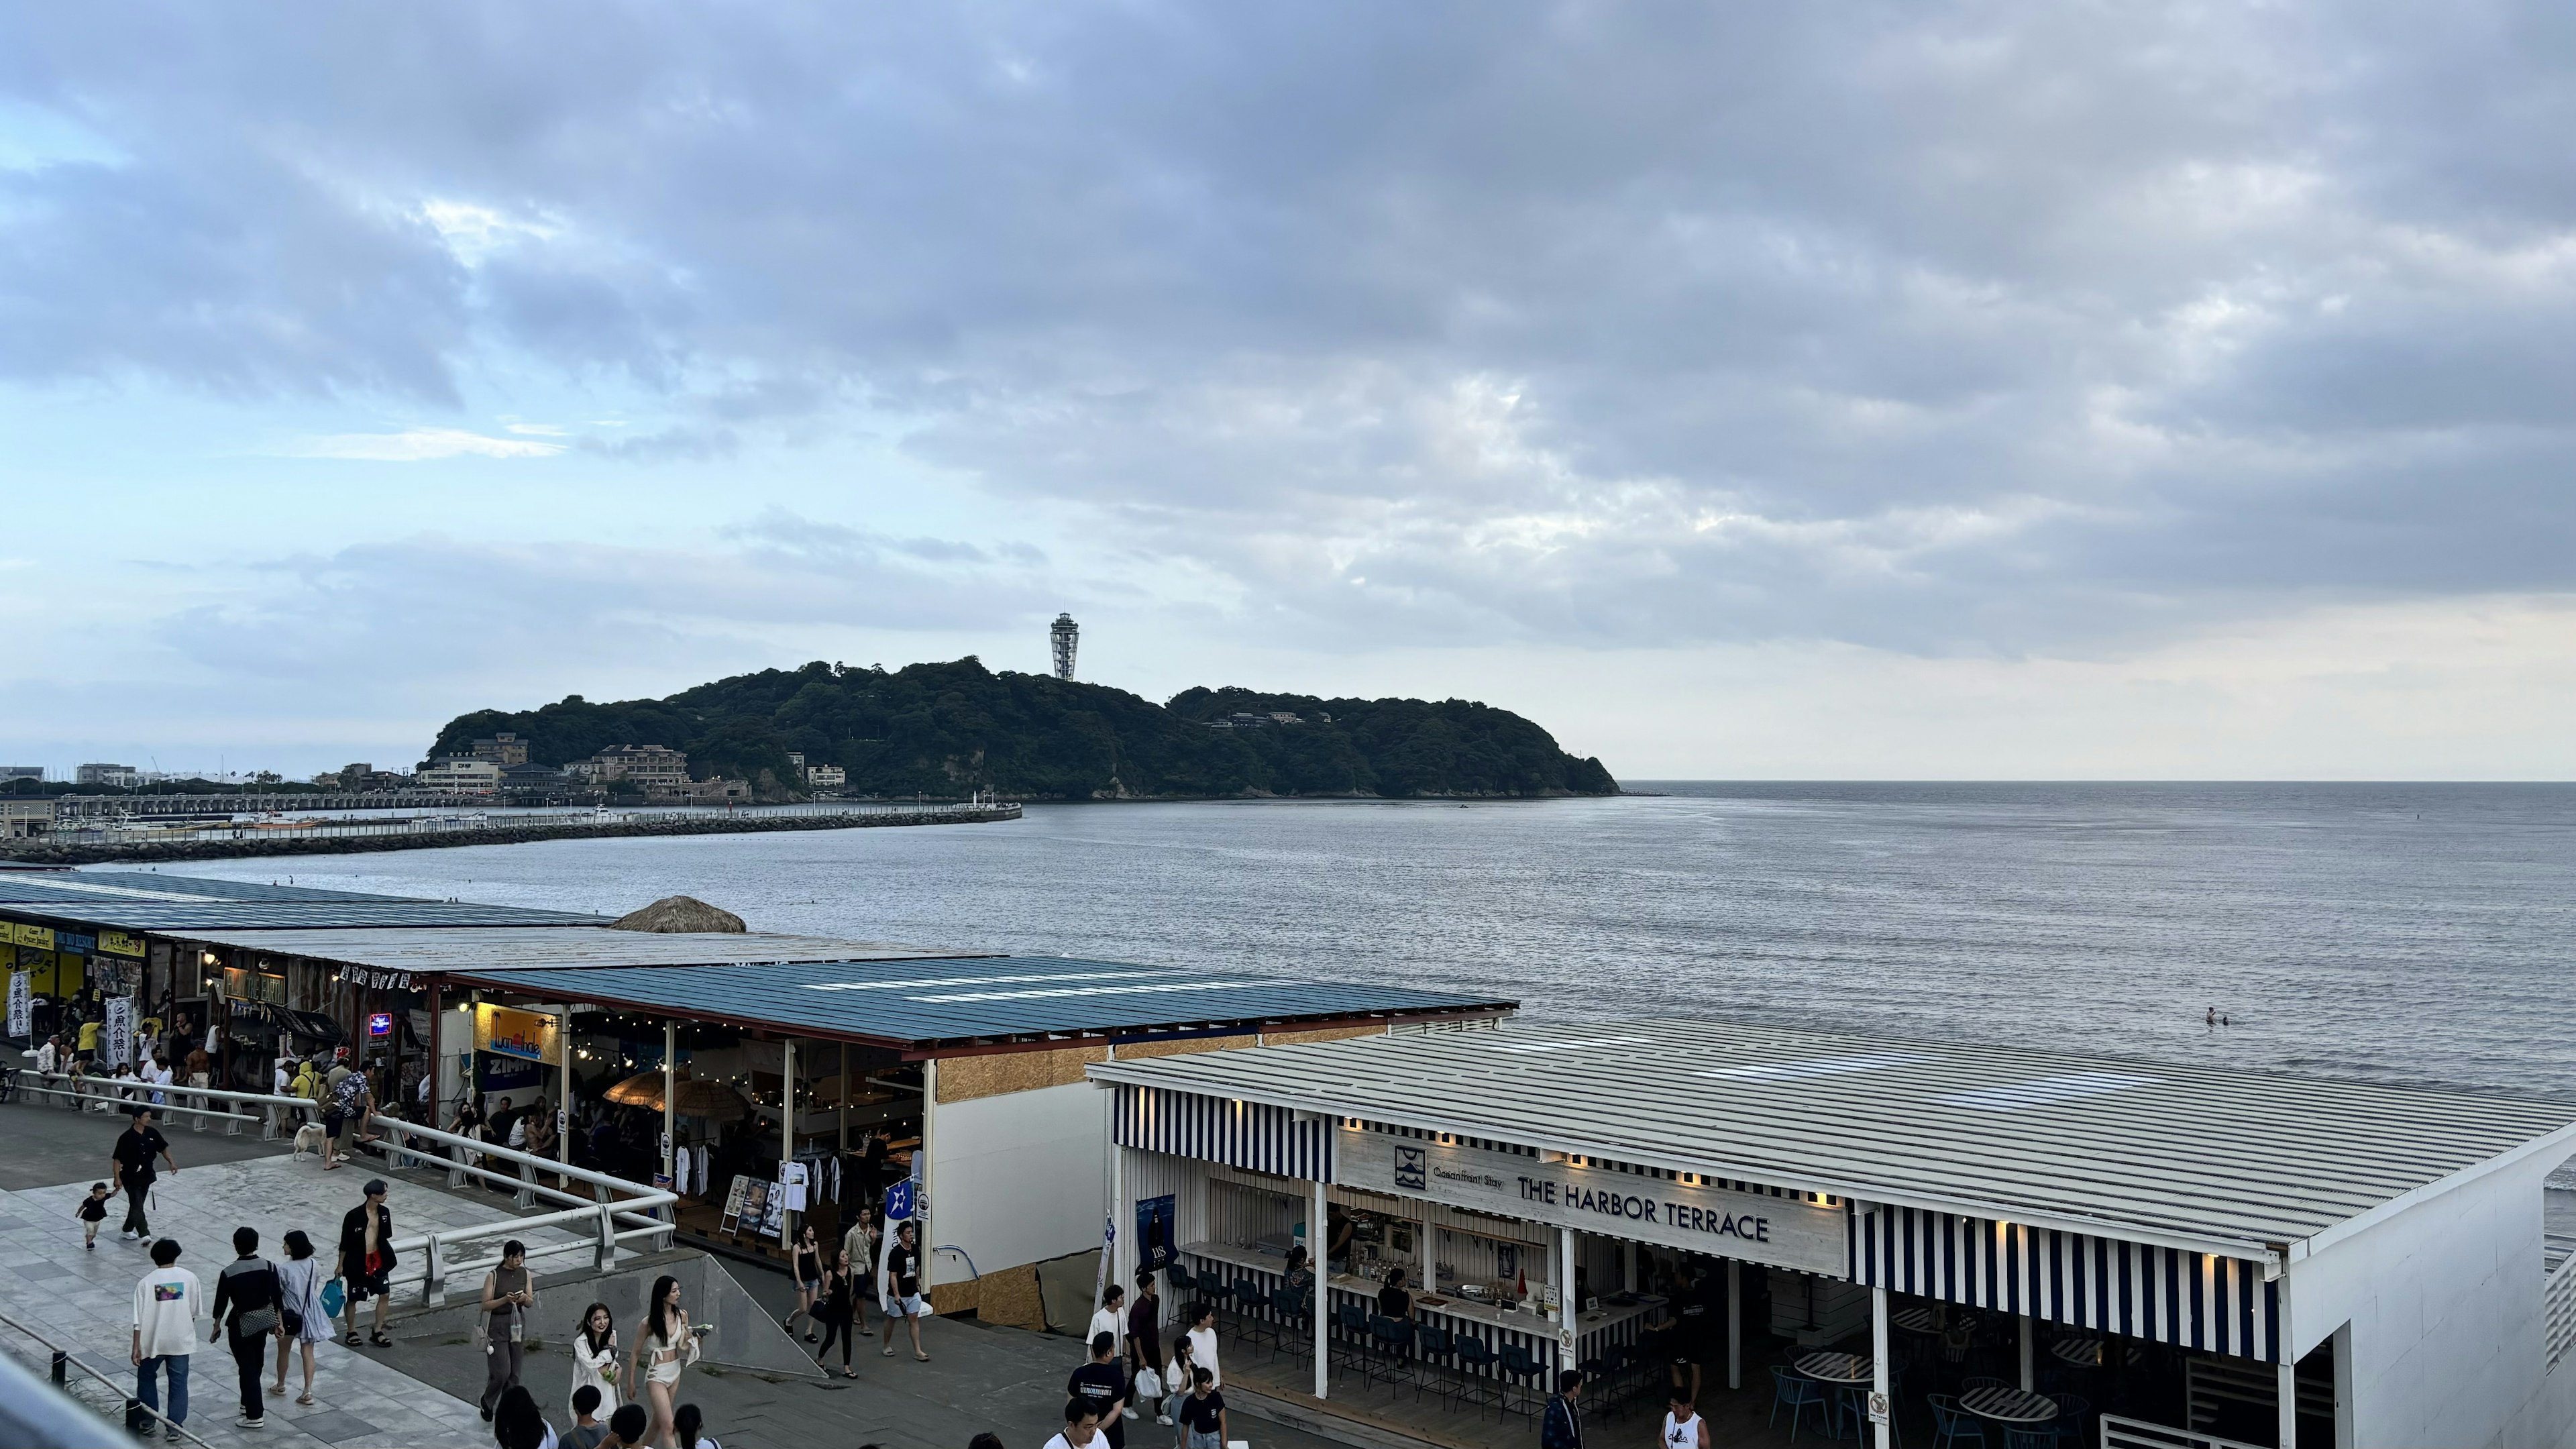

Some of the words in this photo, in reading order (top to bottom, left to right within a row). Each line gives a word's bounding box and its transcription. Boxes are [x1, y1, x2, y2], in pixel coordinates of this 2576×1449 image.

[66, 932, 75, 946] NO
[75, 934, 96, 949] RESORT
[13, 987, 23, 1030] 魚介祭り
[113, 1015, 125, 1062] 魚介祭り
[1433, 1167, 1481, 1184] Oceanfront
[1484, 1175, 1503, 1190] Stay
[1517, 1177, 1557, 1204] THE
[1566, 1185, 1658, 1223] HARBOR
[1664, 1202, 1770, 1242] TERRACE
[1152, 1245, 1167, 1258] 118
